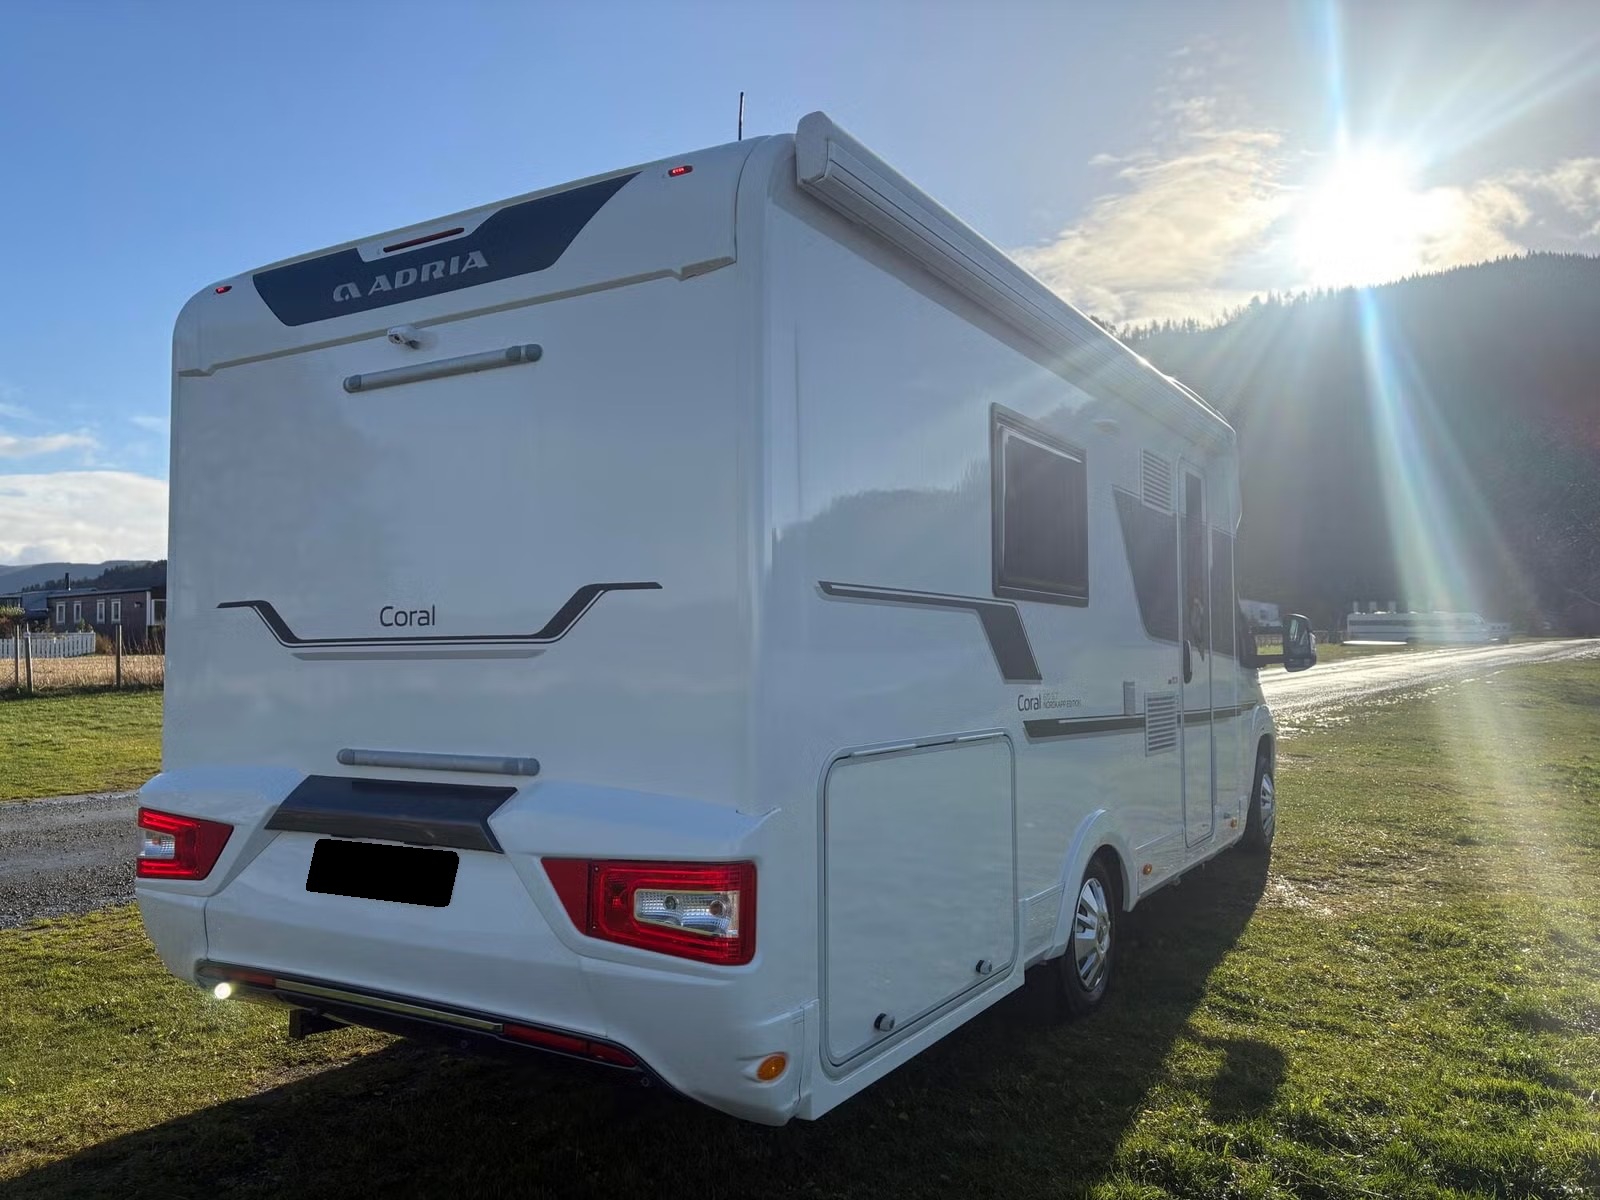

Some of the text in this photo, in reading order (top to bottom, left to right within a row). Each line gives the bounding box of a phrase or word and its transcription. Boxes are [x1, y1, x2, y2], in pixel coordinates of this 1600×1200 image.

[368, 250, 489, 296] ADRIA
[379, 604, 436, 627] Coral
[1017, 694, 1042, 712] Coral
